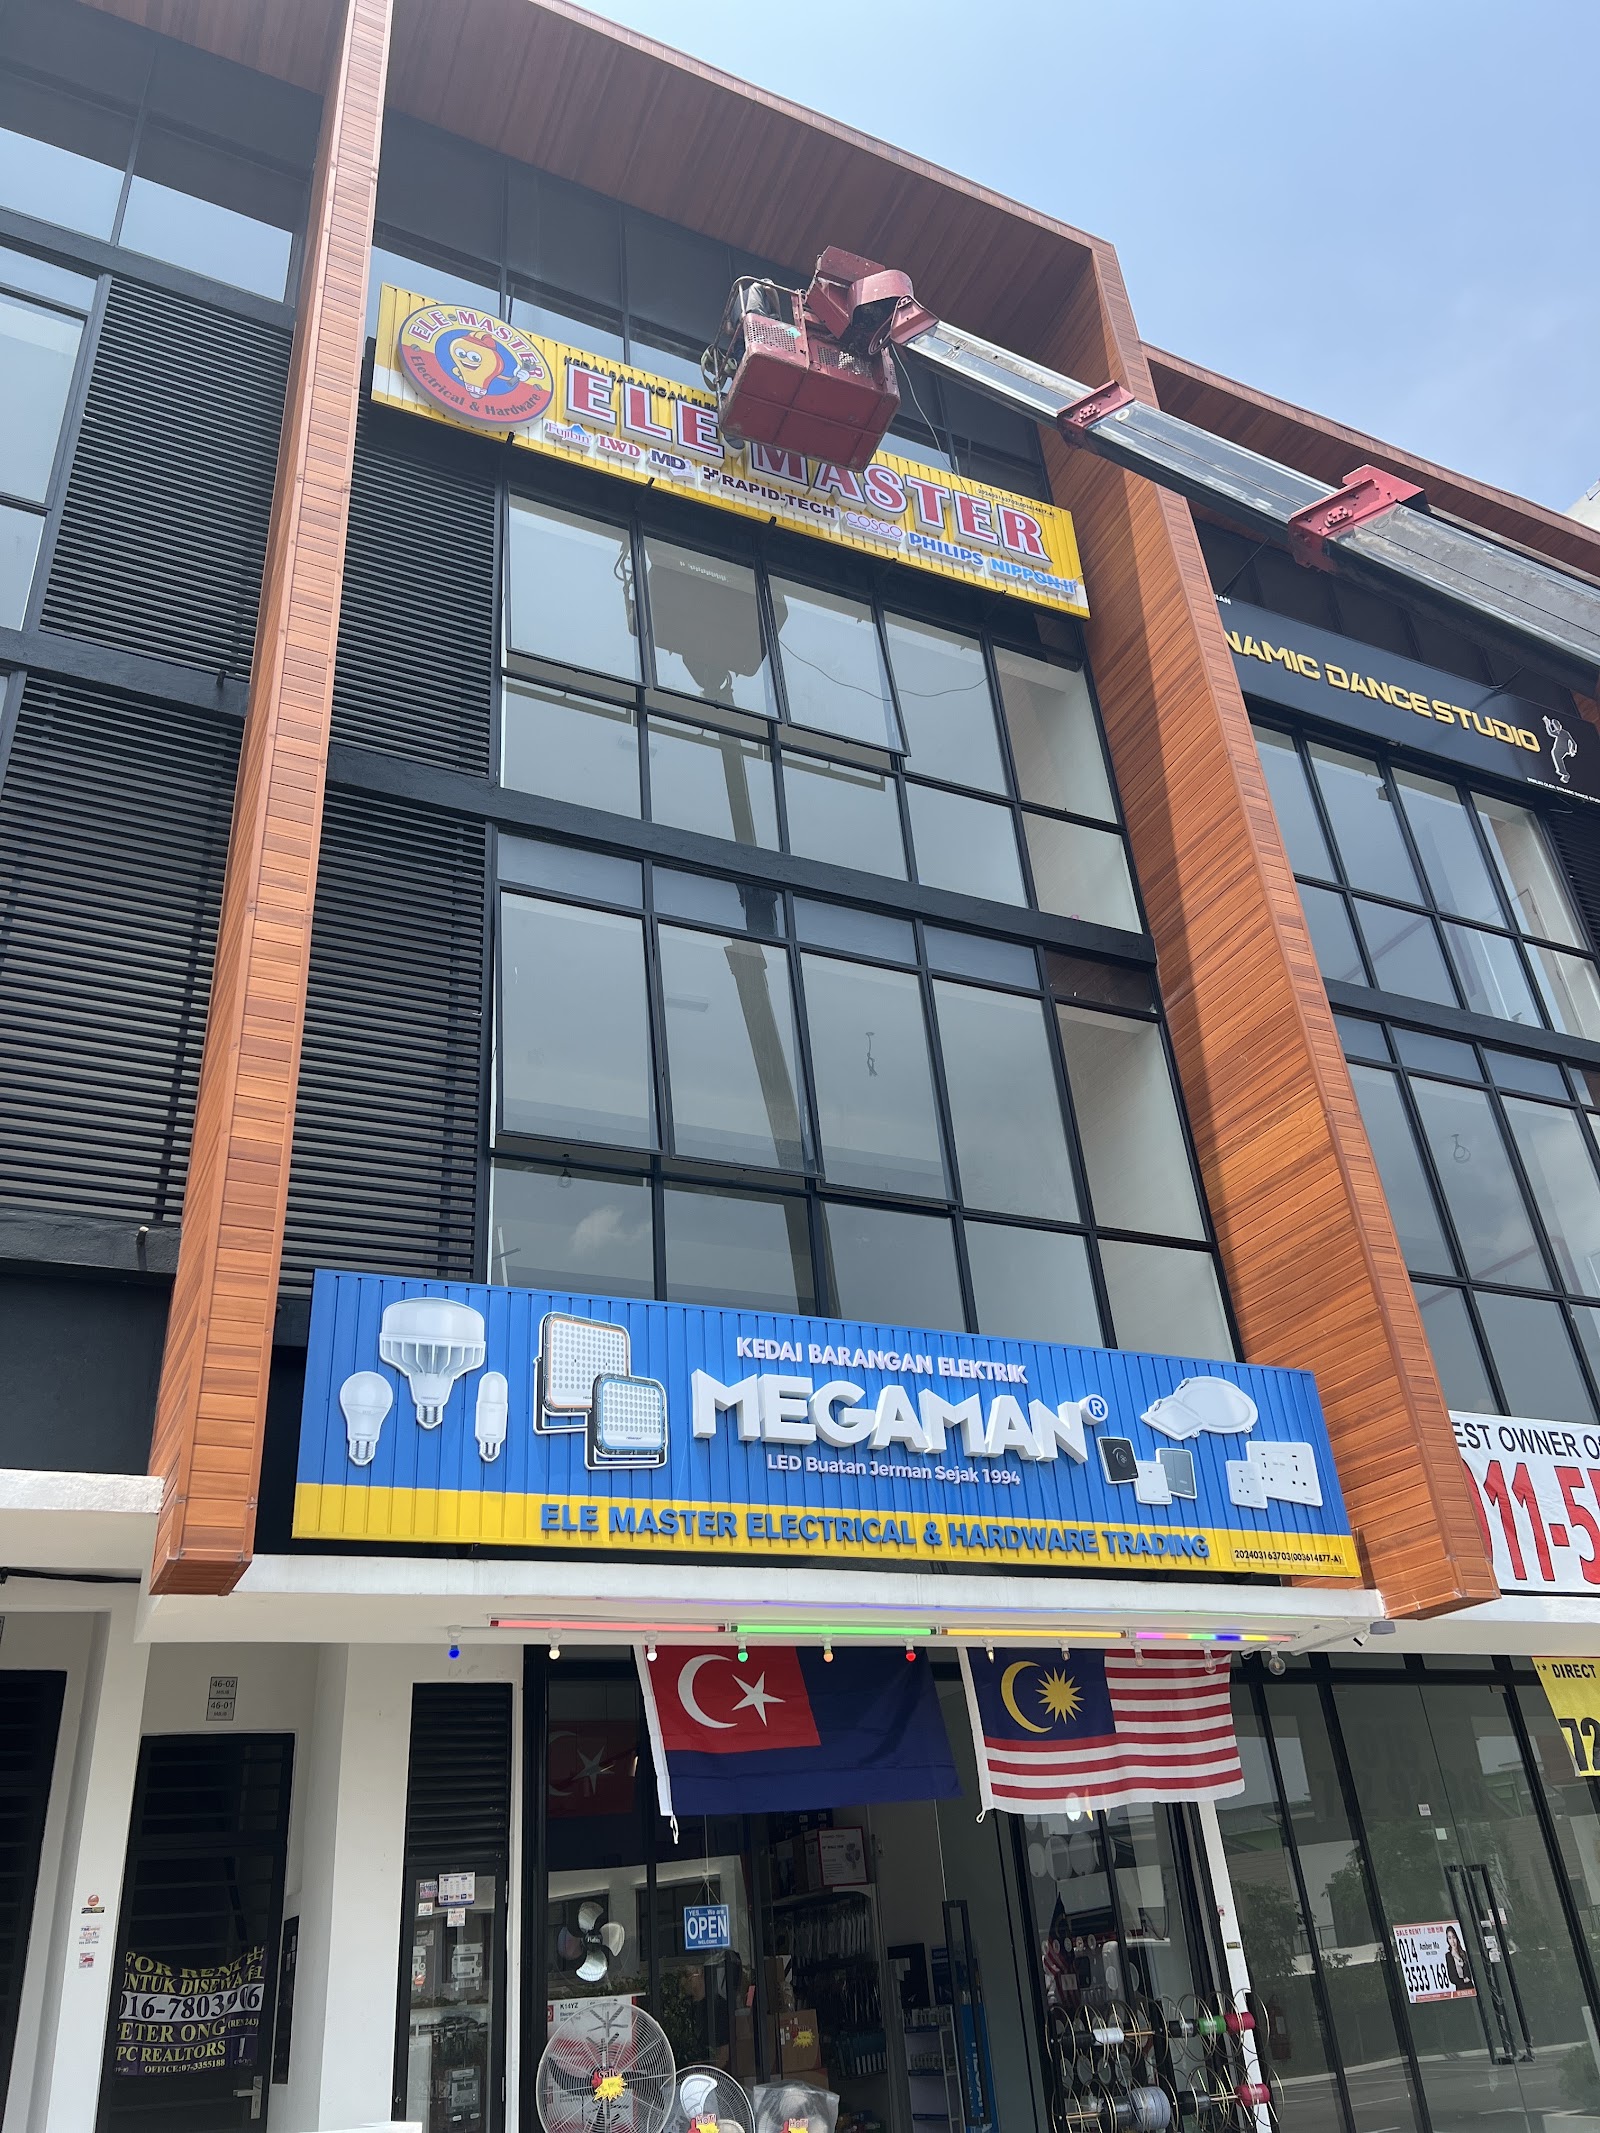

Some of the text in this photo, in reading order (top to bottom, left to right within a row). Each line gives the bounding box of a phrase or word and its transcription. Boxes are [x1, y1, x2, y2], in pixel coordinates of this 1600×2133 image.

[408, 309, 545, 379] ELE MASTER
[410, 354, 466, 406] Electrical
[485, 393, 541, 416] Hardware
[599, 434, 641, 458] LWD
[651, 449, 686, 470] MD
[565, 363, 1053, 563] ELE MASTER
[721, 474, 836, 519] RAPID-TECH
[908, 532, 984, 566] PHILIPS
[1324, 662, 1433, 718] DANCE
[1432, 699, 1541, 753] STUDIO
[736, 1336, 1028, 1385] KEDAI BARANGAN ELEKTRIK
[1498, 1426, 1582, 1458] OWNER
[1583, 1434, 1600, 1460] O
[766, 1453, 1021, 1487] LED Buatan Jerman Sejak 1994
[541, 1503, 1210, 1558] ELE MASTER ELECTRICAL & HARDWARE TRADING
[1462, 1459, 1600, 1585] 11-5
[212, 1680, 235, 1688] 46-02
[1551, 1663, 1597, 1679] DIRECT
[210, 1701, 233, 1709] 46-01
[687, 1915, 727, 1940] OPEN
[1396, 1929, 1409, 1937] SALE
[1398, 1937, 1419, 1965] 014
[180, 1972, 243, 1996] DISEWA
[1405, 1962, 1450, 1993] 3533 168
[180, 2018, 226, 2042] ONG
[140, 2040, 226, 2062] REALTORS
